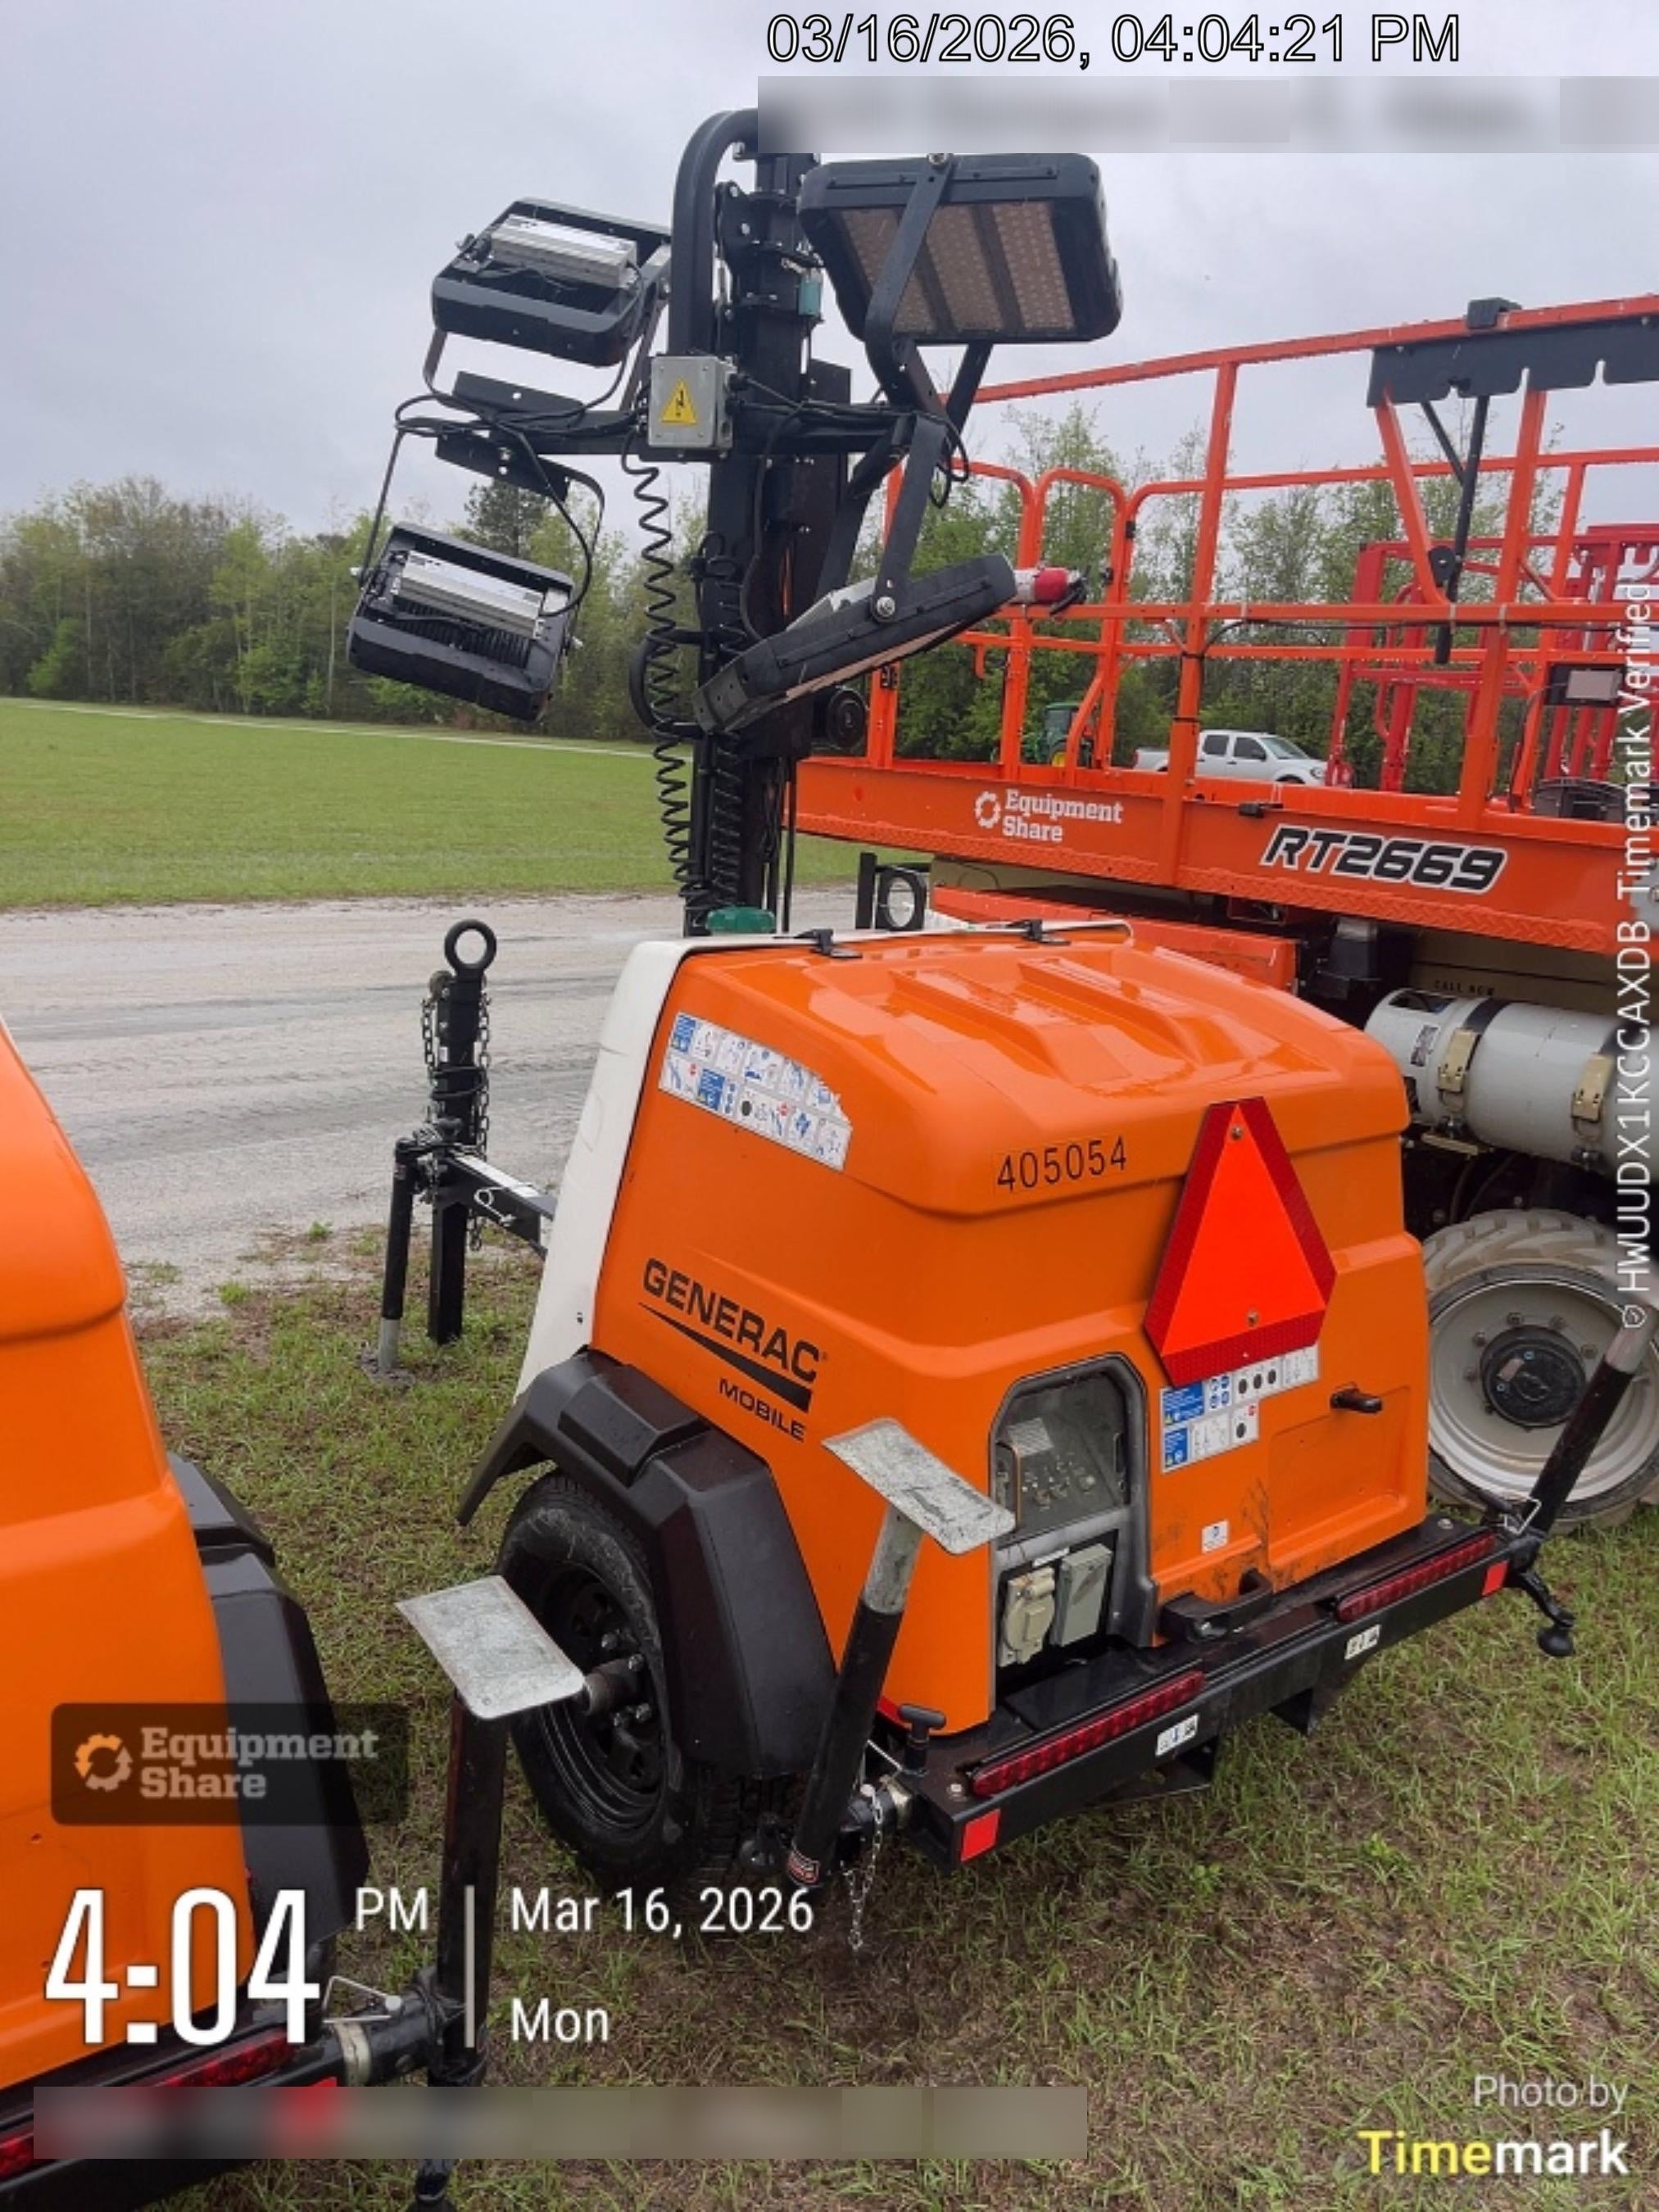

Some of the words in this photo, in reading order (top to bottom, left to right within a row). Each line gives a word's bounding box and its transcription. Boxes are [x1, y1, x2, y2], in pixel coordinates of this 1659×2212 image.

[1002, 815, 1063, 842] Share
[1004, 788, 1124, 824] Equipment
[1260, 823, 1508, 895] RT2669
[997, 1135, 1127, 1192] 405054
[642, 1257, 820, 1384] GENERAC
[718, 1378, 806, 1443] MOBILE
